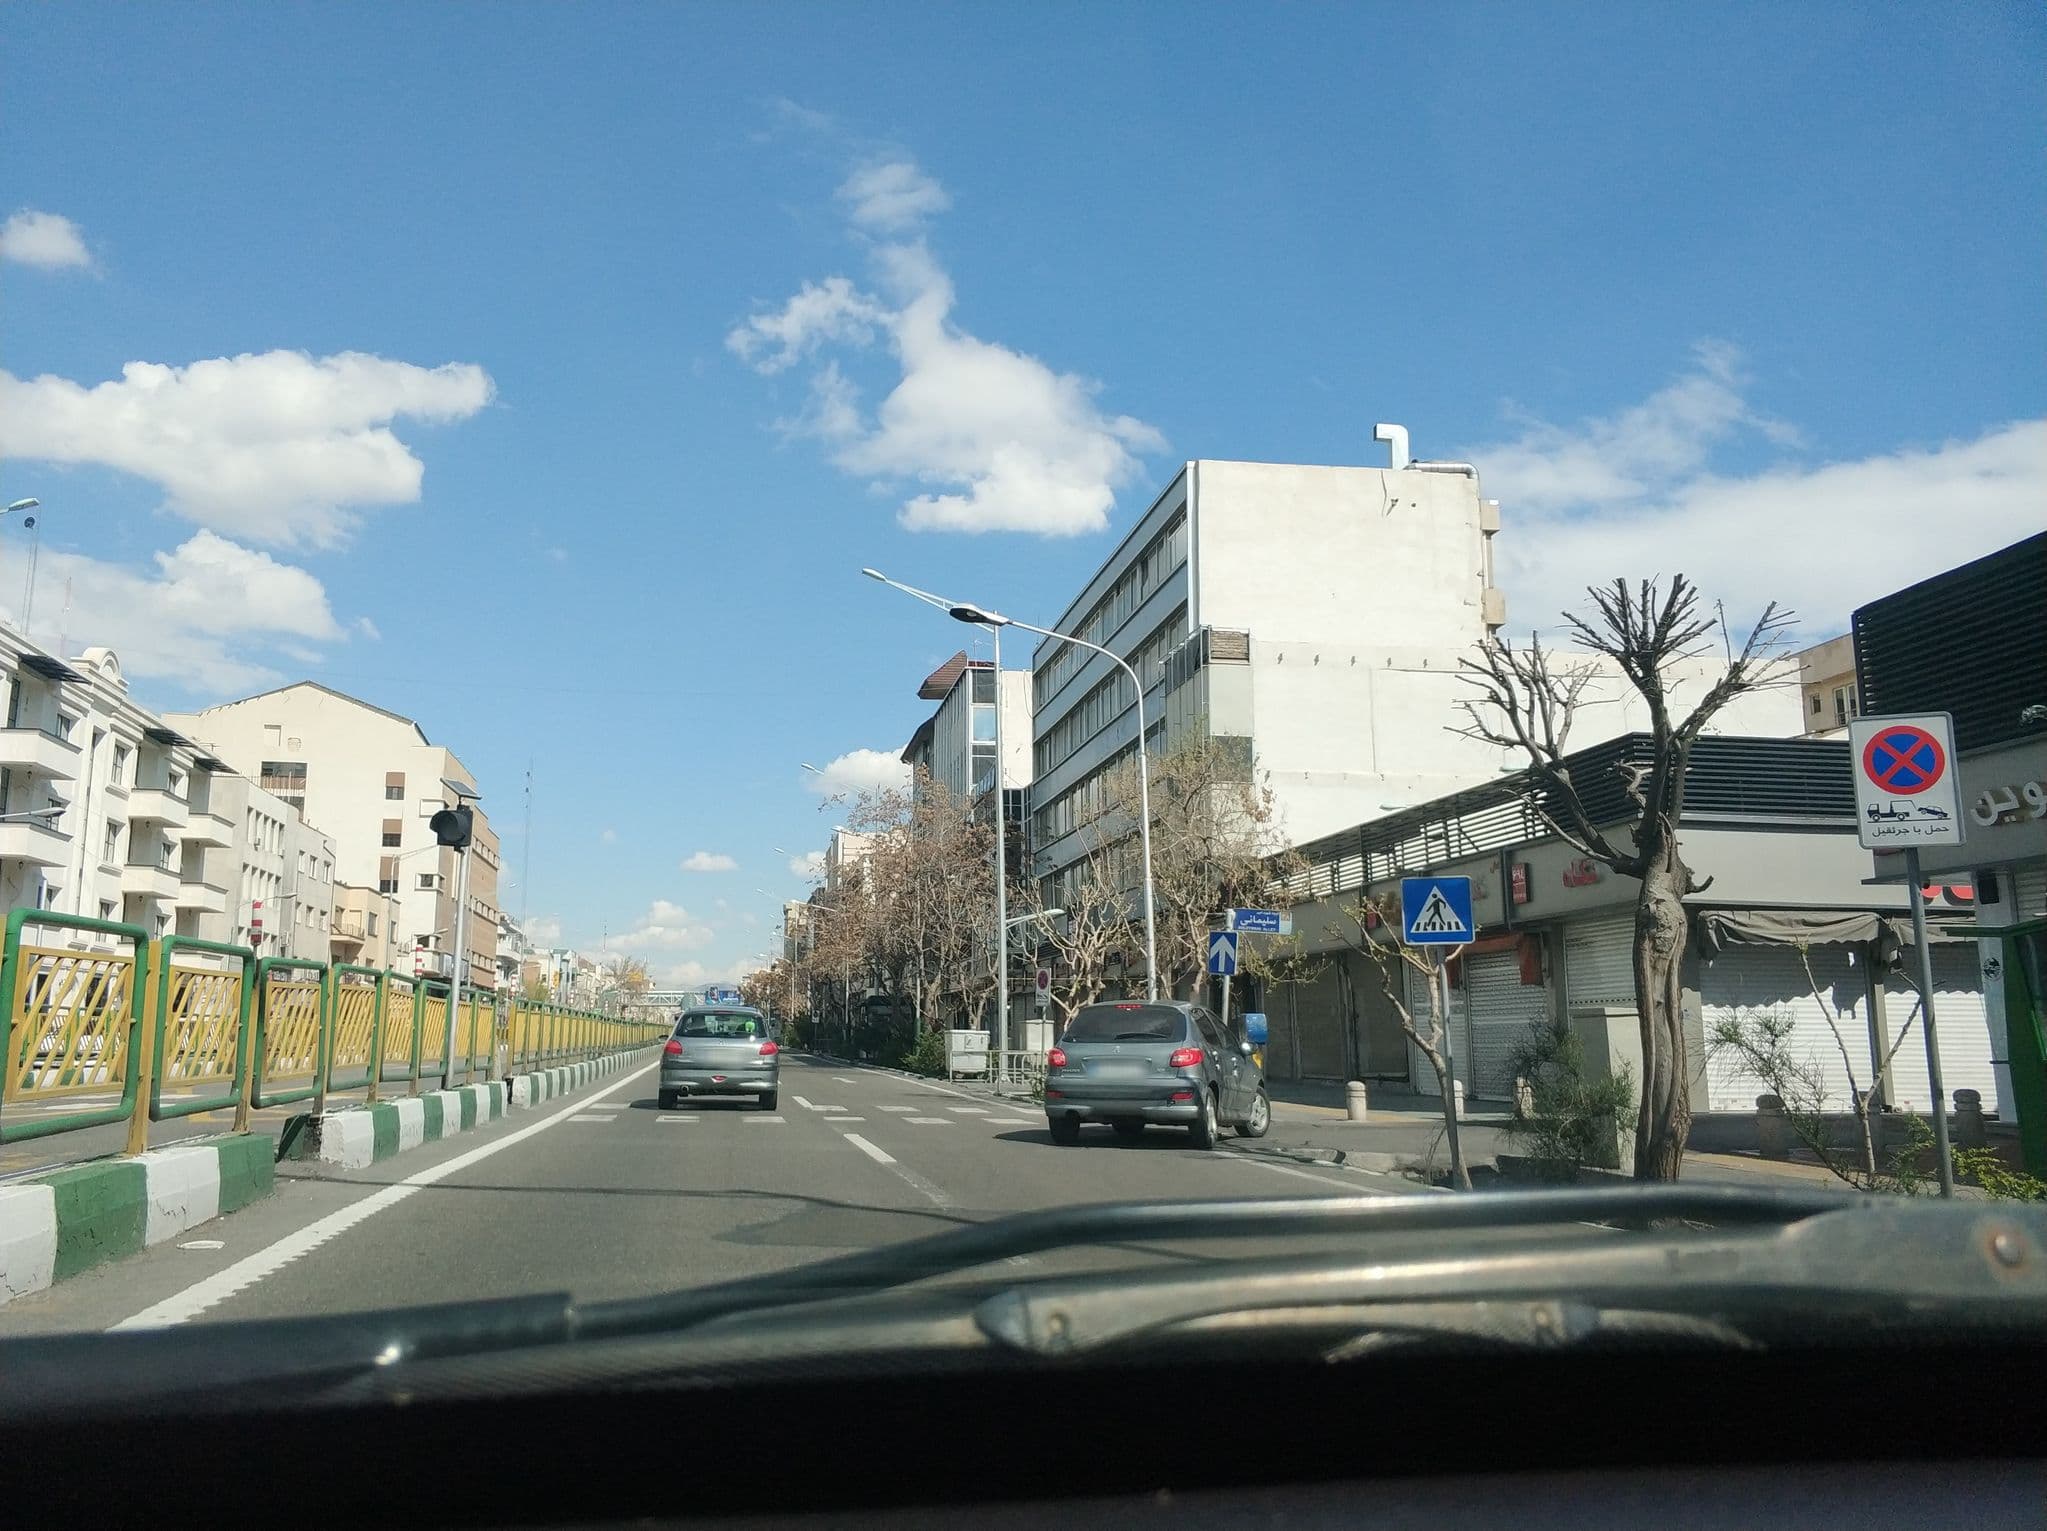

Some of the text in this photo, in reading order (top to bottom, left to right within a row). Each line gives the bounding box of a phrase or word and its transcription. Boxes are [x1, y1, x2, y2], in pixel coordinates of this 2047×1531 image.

[1871, 825, 1950, 838] حمل با جرثقیل
[1240, 914, 1277, 926] سلیمانی
